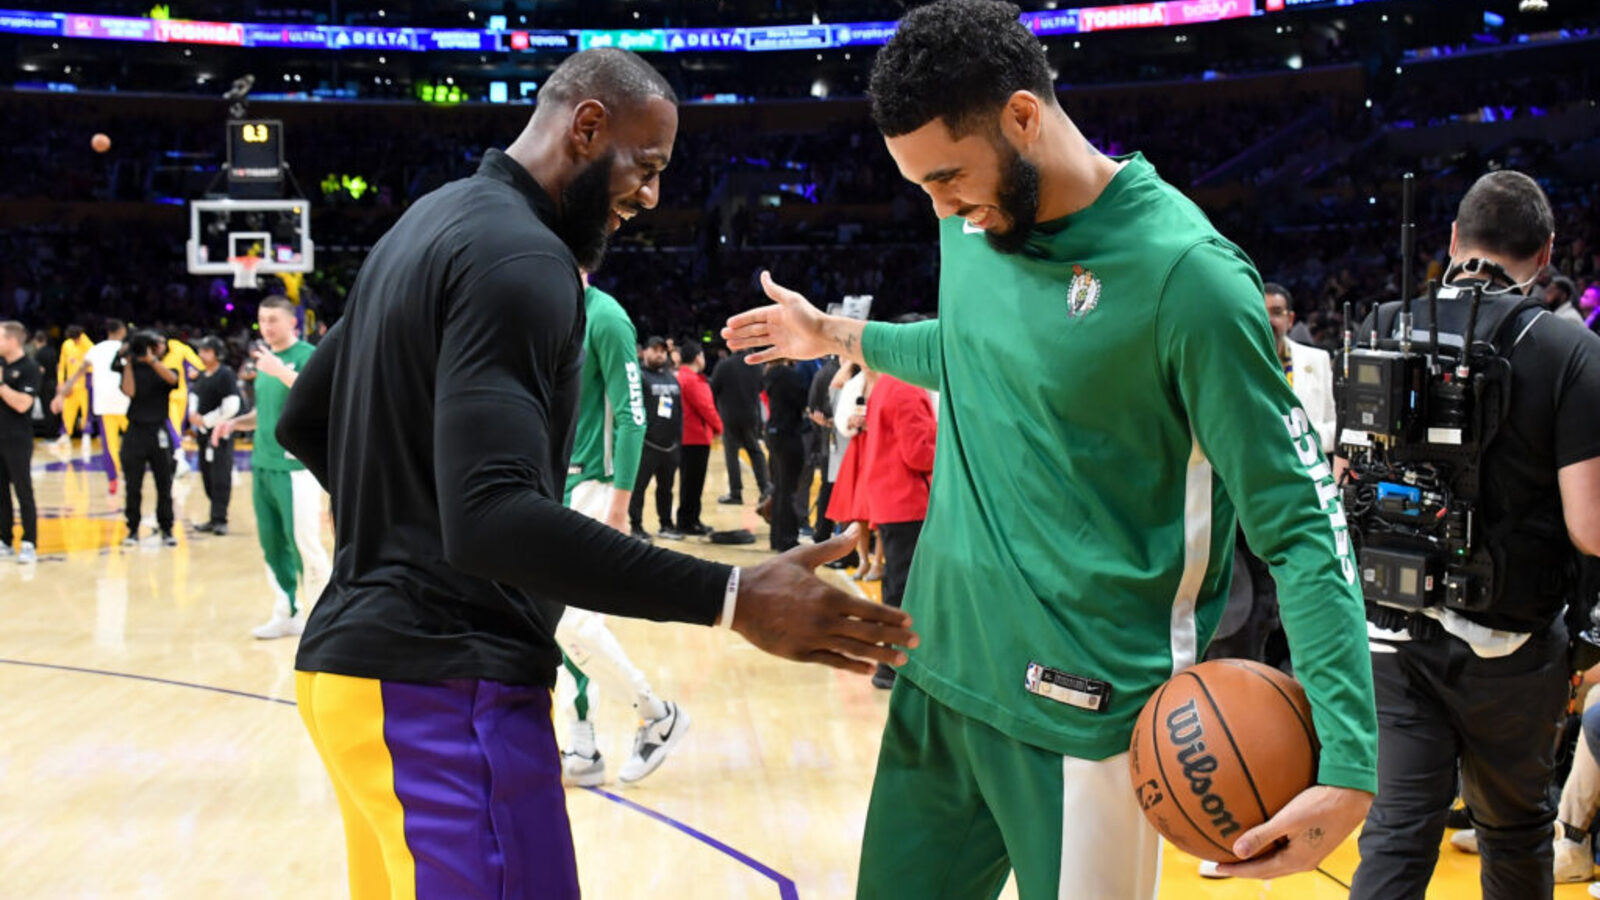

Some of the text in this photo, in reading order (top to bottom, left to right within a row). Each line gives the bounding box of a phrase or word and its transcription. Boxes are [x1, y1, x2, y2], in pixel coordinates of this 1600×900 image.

[1041, 17, 1076, 28] ULTRA
[1084, 7, 1163, 28] TOSHIBA
[161, 22, 240, 41] TOSHIBA
[288, 31, 325, 42] ULTRA
[352, 31, 409, 46] DELTA
[687, 33, 743, 47] DELTA
[624, 361, 646, 426] CELTICS
[1281, 406, 1356, 586] CELTICS
[1165, 697, 1242, 838] Wilson
